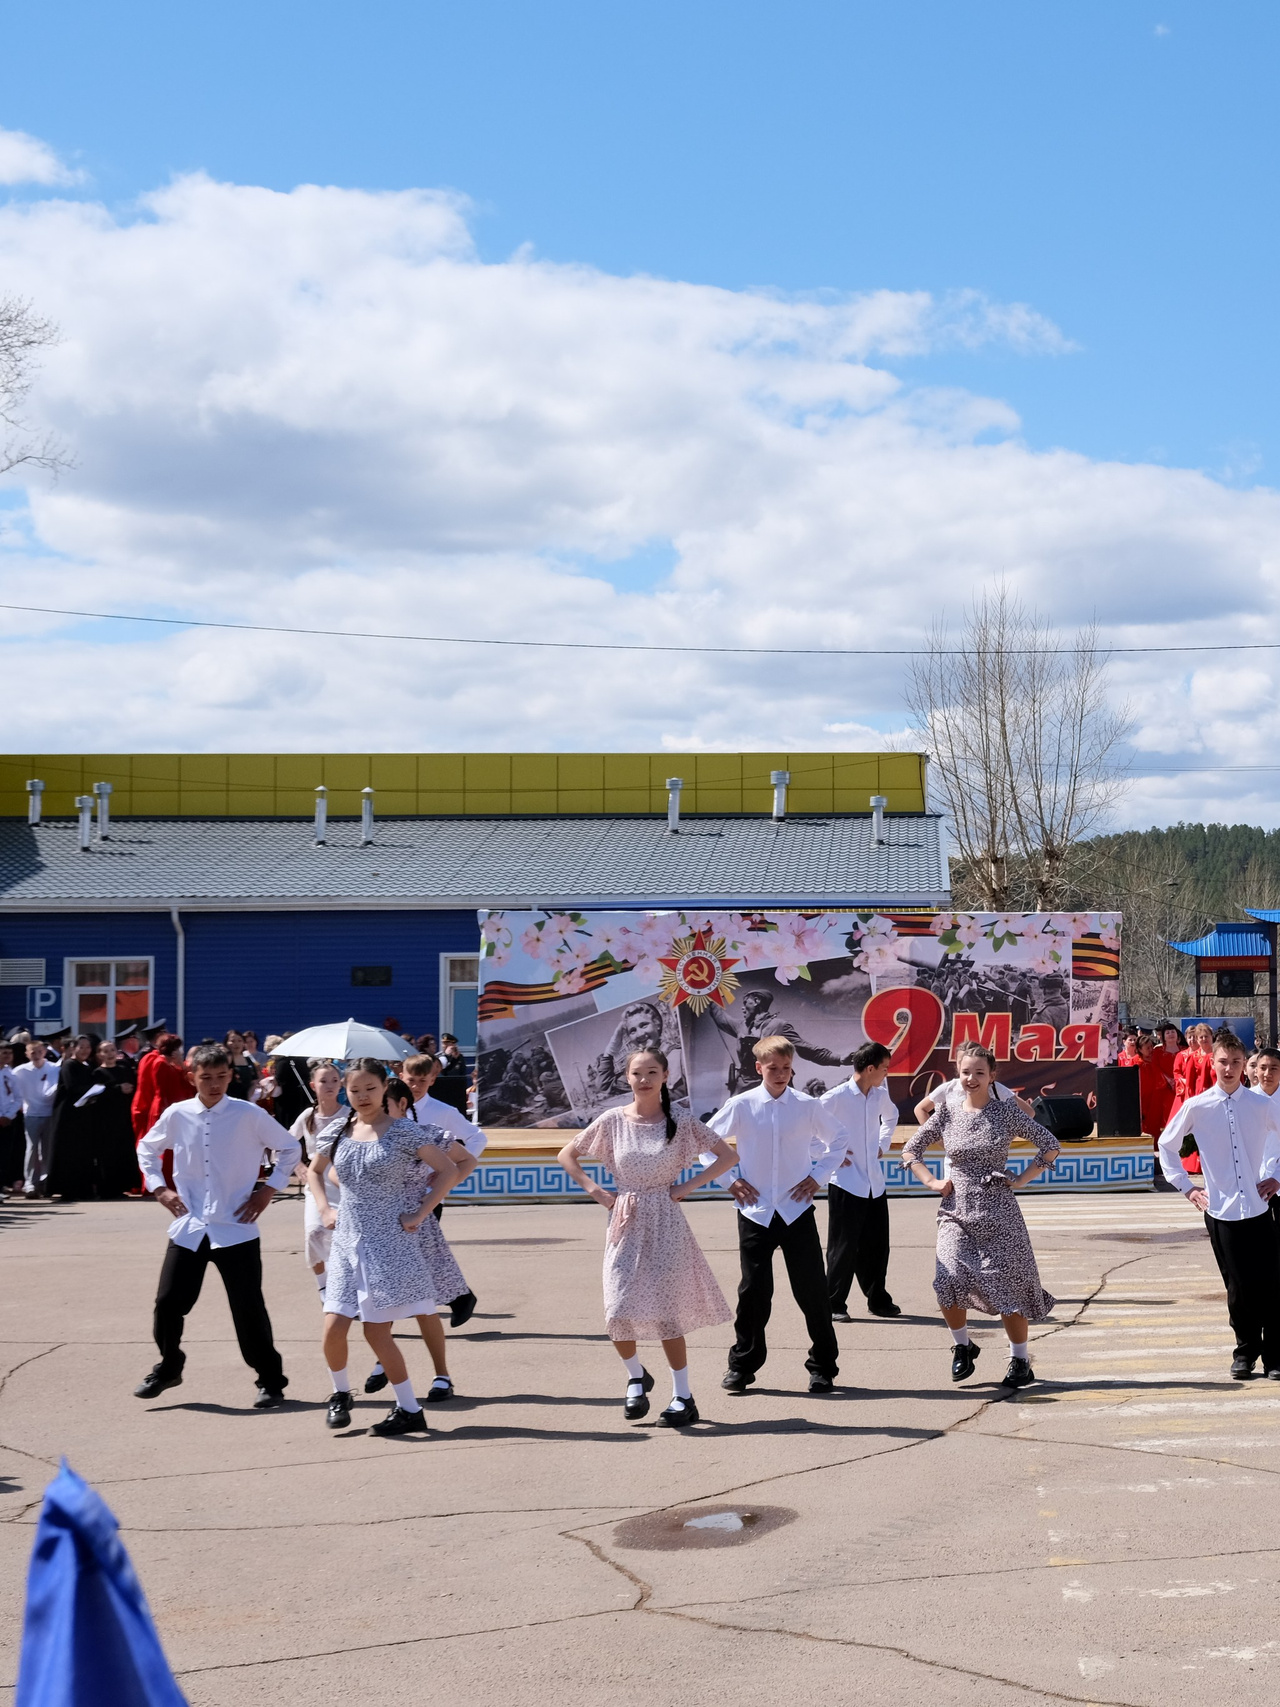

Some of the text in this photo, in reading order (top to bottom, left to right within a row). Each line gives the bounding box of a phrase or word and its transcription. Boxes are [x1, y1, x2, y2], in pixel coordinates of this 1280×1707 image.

[677, 950, 718, 991] ОТЕЧЕСТВЕННАЯ
[861, 985, 1103, 1077] 9 Мая
